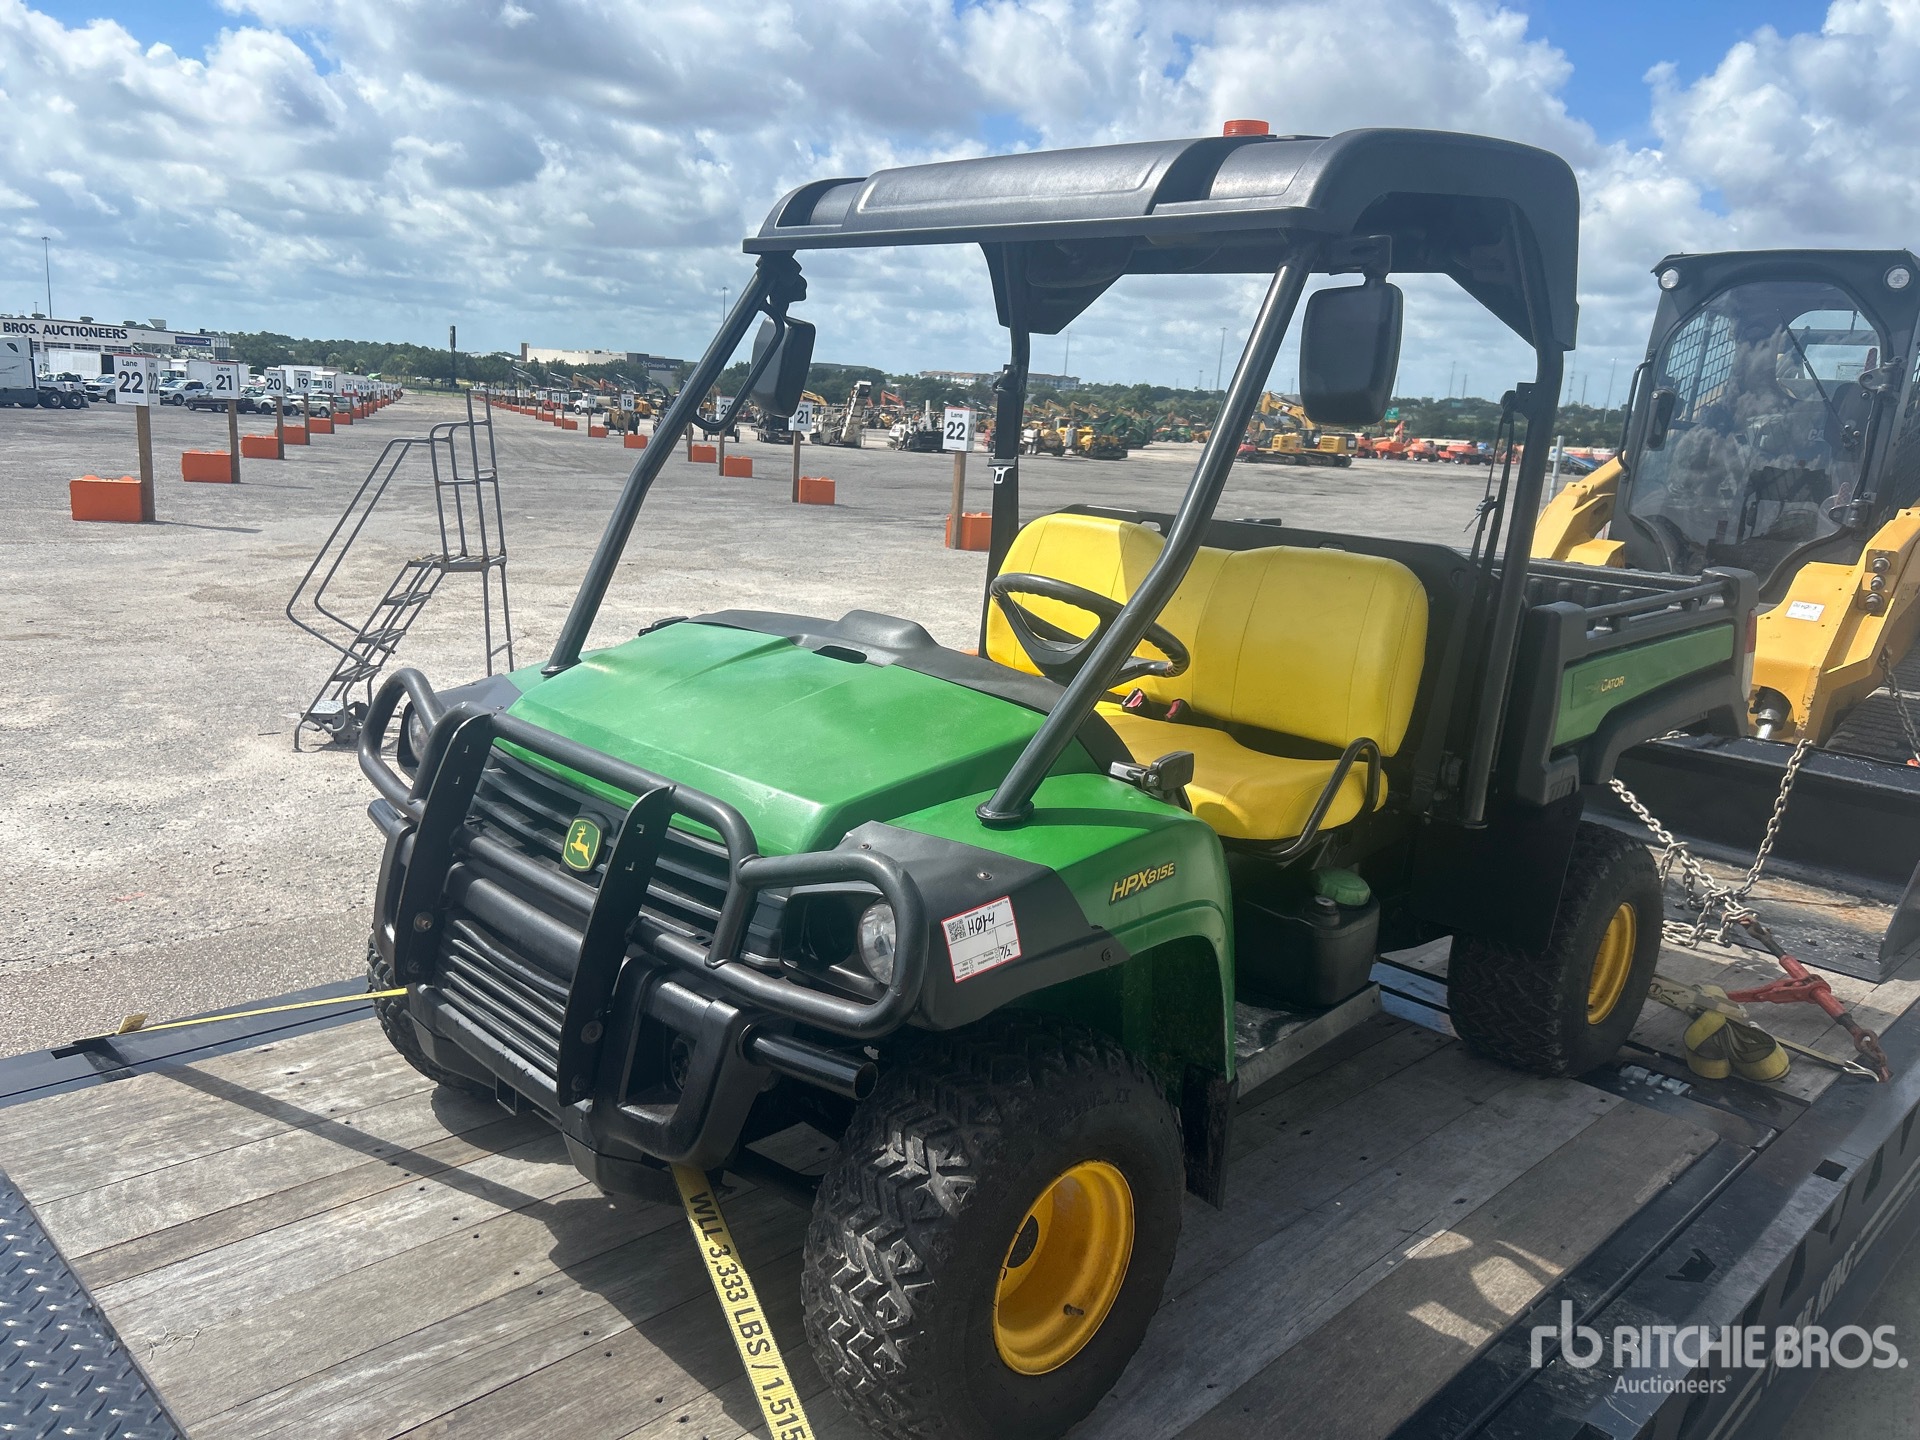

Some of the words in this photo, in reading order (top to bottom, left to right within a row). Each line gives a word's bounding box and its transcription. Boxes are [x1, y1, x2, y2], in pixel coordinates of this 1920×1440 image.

[3, 321, 40, 335] BROS.
[43, 324, 128, 340] AUCTIONEERS
[121, 359, 138, 367] Lane
[118, 370, 144, 394] 22
[215, 374, 232, 391] 21
[266, 378, 281, 391] 20
[296, 378, 308, 389] 19
[323, 380, 333, 389] 18
[589, 397, 595, 405] 17
[623, 399, 632, 407] 18
[797, 410, 809, 424] 21
[946, 421, 966, 441] 22
[1110, 862, 1175, 902] HPX815E
[689, 1191, 723, 1242] WLL
[708, 1244, 749, 1303] 3,333
[733, 1306, 771, 1356] LBS
[762, 1376, 807, 1440] 1,515
